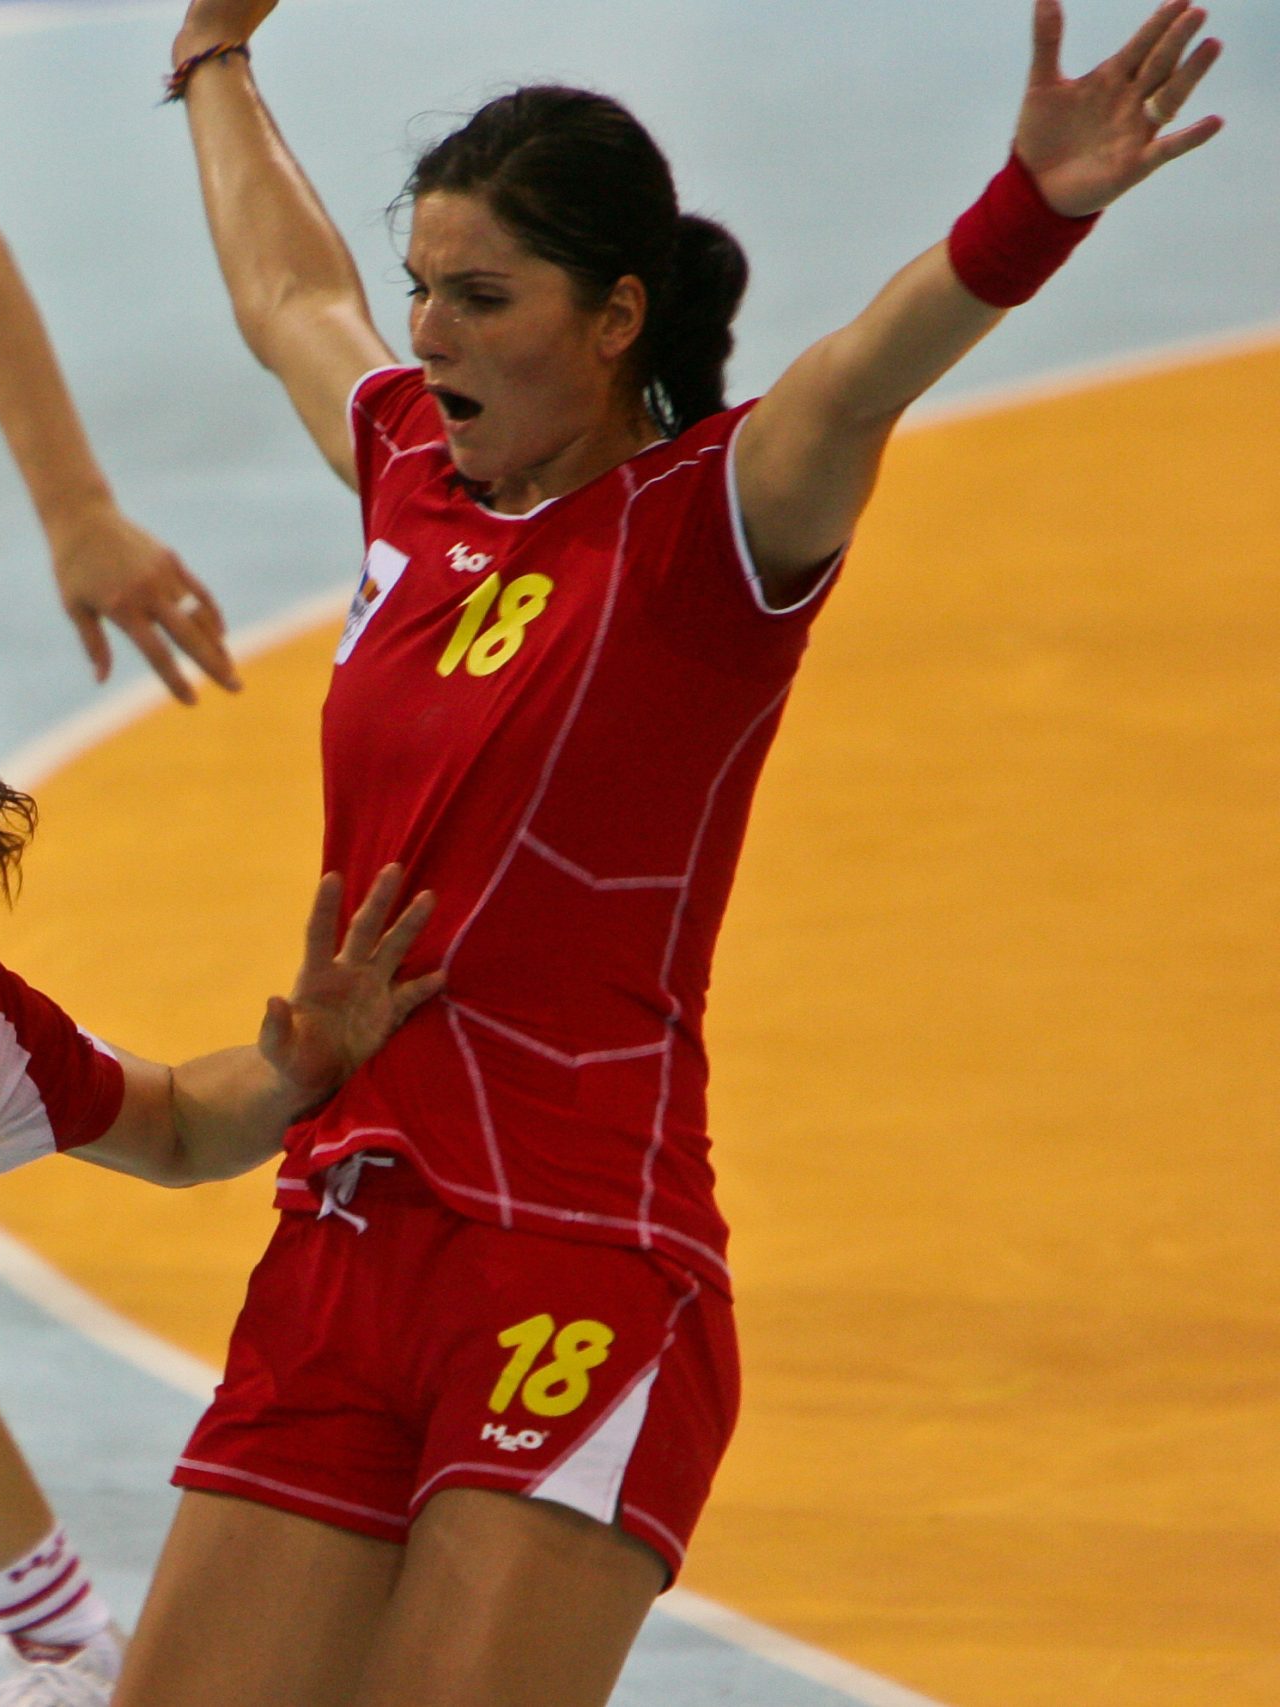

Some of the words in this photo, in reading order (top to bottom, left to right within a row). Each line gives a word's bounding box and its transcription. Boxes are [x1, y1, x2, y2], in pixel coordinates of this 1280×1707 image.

[436, 571, 554, 677] 18
[489, 1313, 615, 1417] 18
[480, 1422, 547, 1452] H2O
